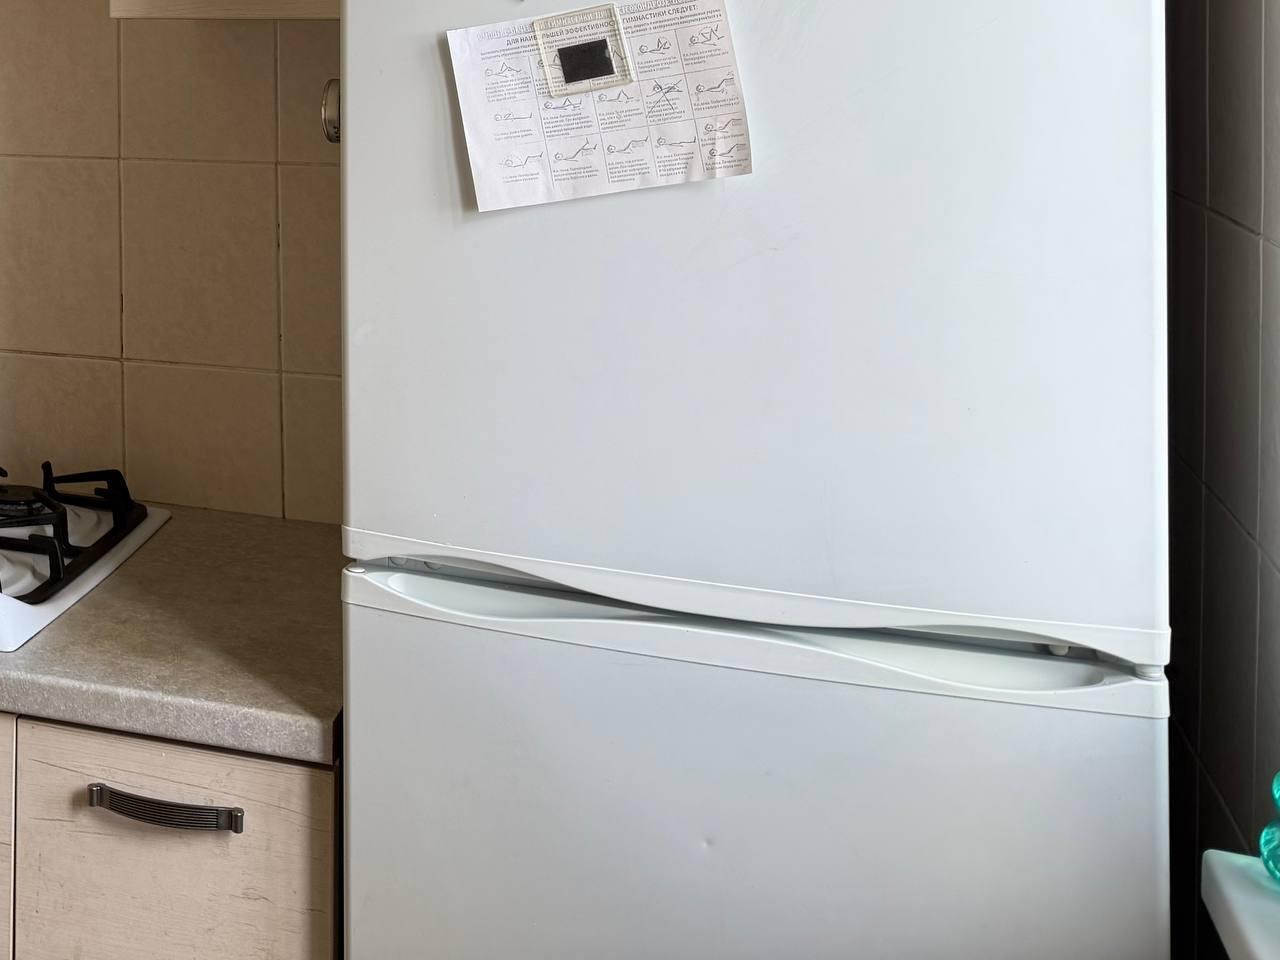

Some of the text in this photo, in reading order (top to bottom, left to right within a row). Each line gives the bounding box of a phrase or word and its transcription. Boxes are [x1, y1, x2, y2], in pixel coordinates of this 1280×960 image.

[506, 37, 519, 46] ДЛЯ
[622, 9, 667, 25] ГИМНАСТИКИ
[667, 4, 698, 16] СЛЕДУЕТ:
